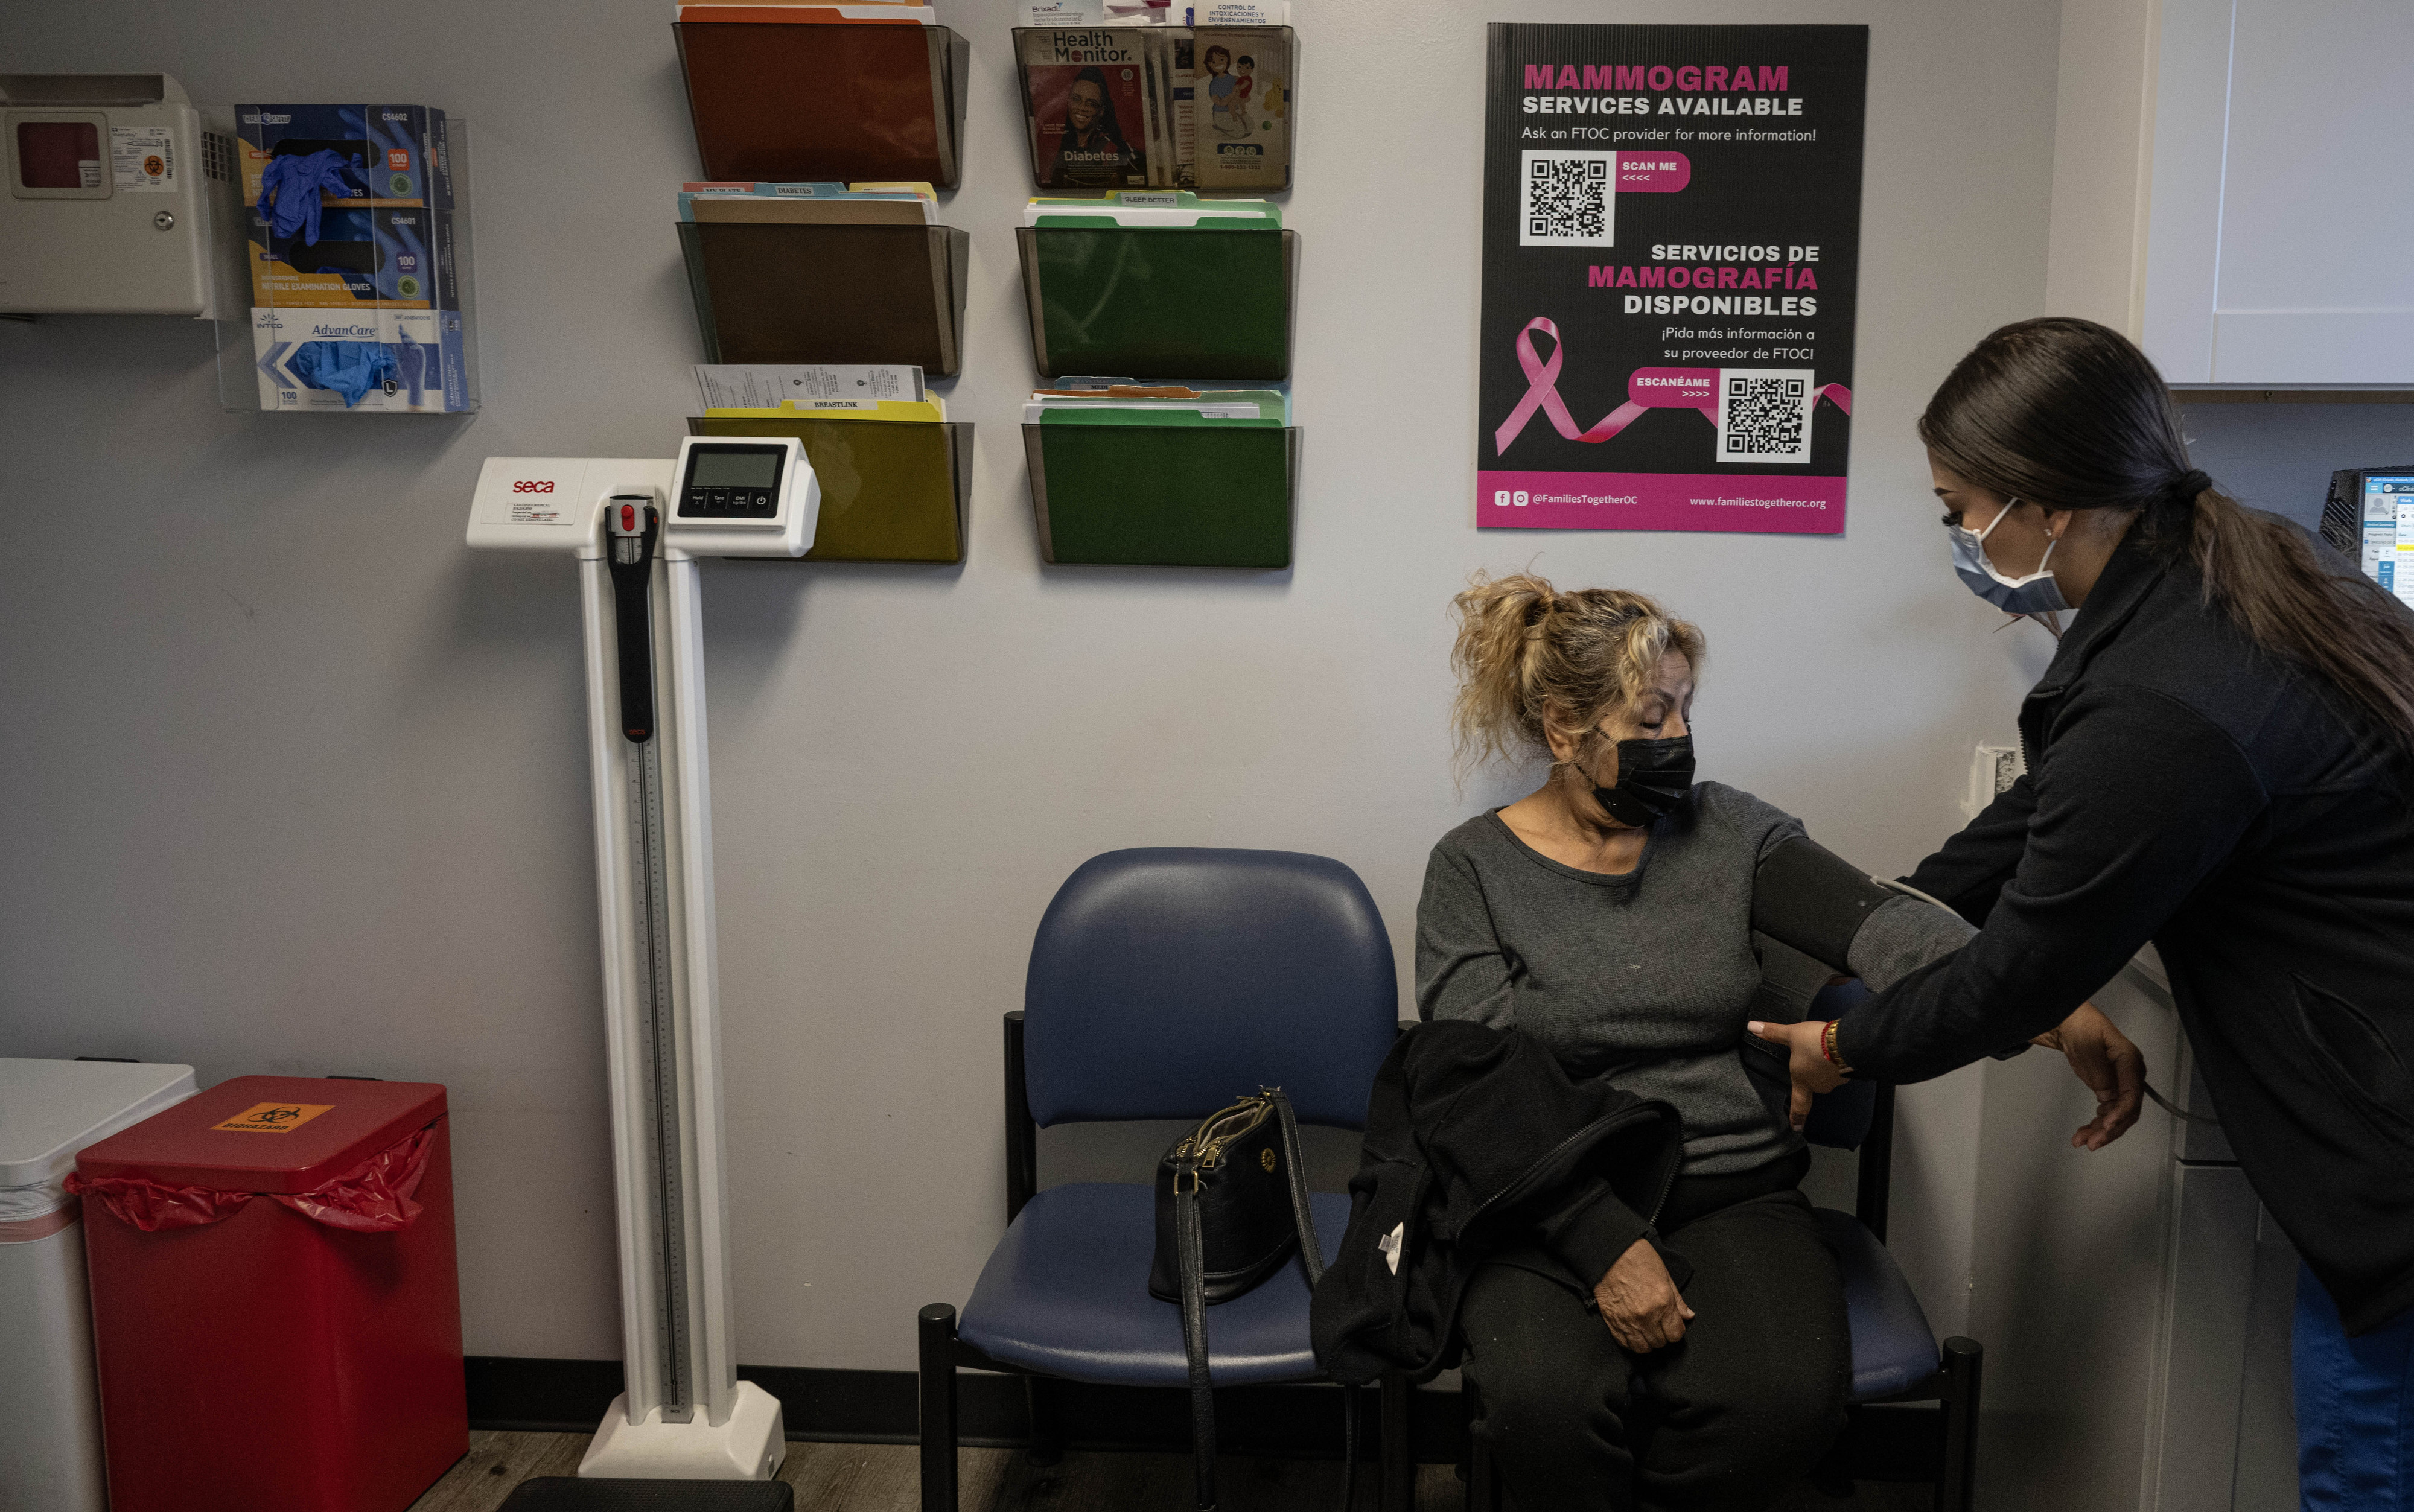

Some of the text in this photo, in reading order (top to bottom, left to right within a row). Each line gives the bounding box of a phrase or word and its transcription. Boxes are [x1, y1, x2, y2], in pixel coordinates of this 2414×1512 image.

[1054, 31, 1113, 46] Health
[1524, 64, 1788, 91] MAMMOGRAM
[1523, 96, 1803, 115] SERVICES AVAILABLE
[1521, 127, 1816, 142] Ask an FTOC provider for more information!
[389, 153, 407, 164] 100
[1063, 151, 1119, 161] Diabetes
[1622, 162, 1677, 171] SCAN ME
[1651, 244, 1820, 262] SERVICIOS DE
[398, 256, 415, 266] 100
[1588, 262, 1818, 290] MAMOGRAFÍA
[261, 282, 290, 291] NITRILE
[291, 282, 341, 291] EXAMINATION
[1624, 295, 1817, 316] DISPONIBLES
[312, 325, 376, 335] AdvanCare
[1662, 326, 1694, 341] ¡Pida
[1698, 327, 1723, 339] más
[1727, 328, 1802, 340] información
[1664, 347, 1814, 361] su proveedor de FTOC!
[1637, 373, 1710, 387] ESCANÉAME
[386, 382, 393, 392] L
[512, 481, 555, 493] seca
[1533, 494, 1637, 506] @FamiliesTogetherOC
[1690, 497, 1826, 510] www.familiestogetheroc.org
